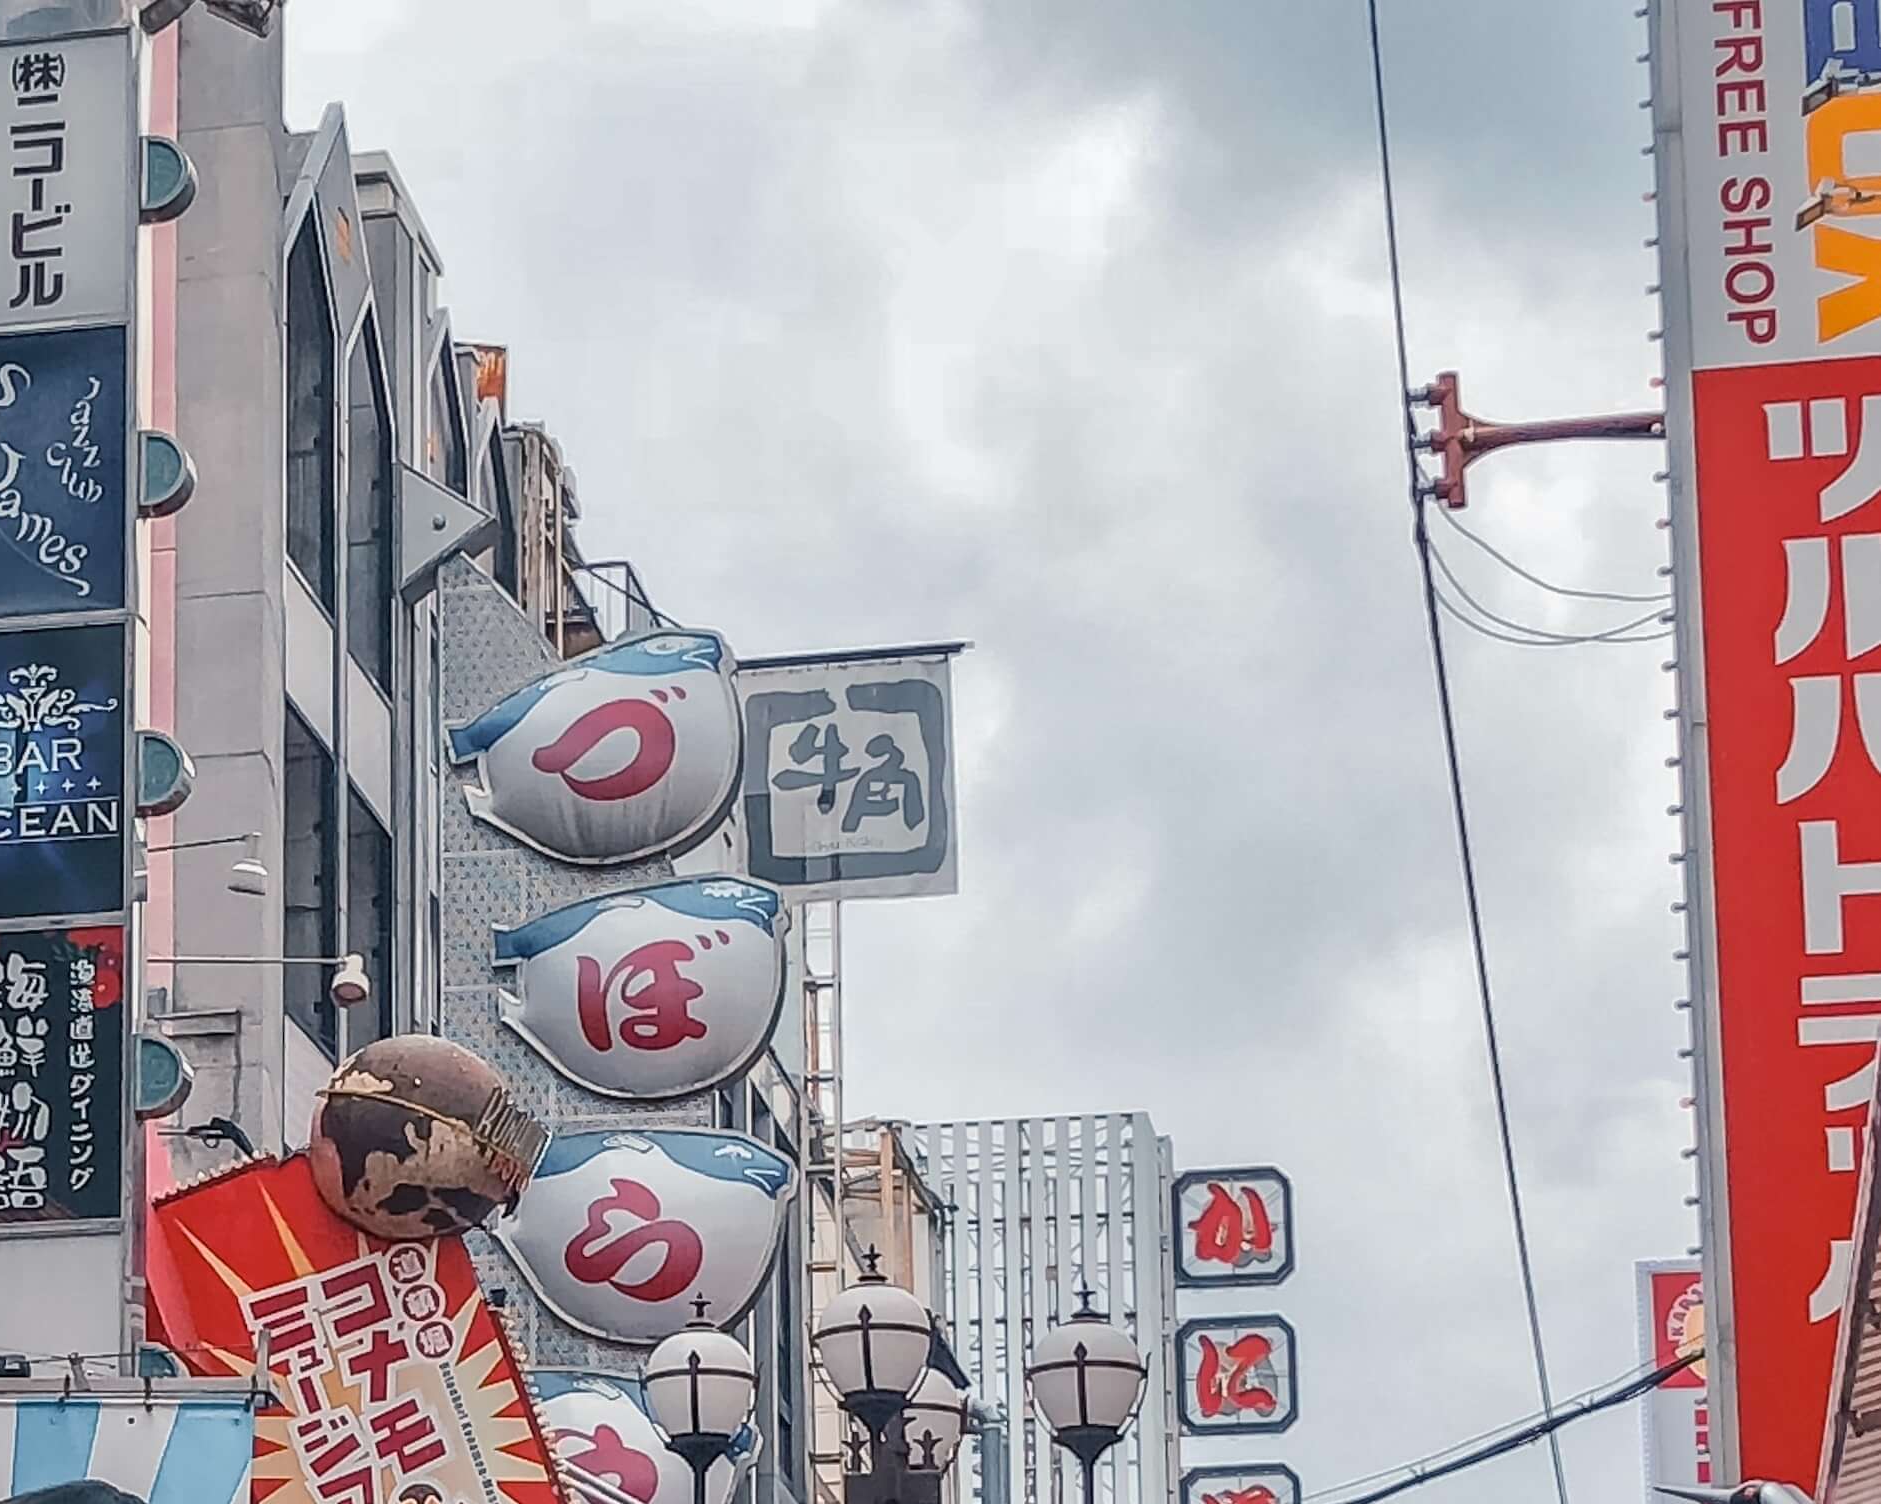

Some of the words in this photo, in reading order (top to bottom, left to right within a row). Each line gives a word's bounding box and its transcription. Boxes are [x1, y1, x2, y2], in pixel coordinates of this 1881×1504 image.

[1713, 0, 1769, 157] FREE
[1720, 177, 1778, 345] SHOP
[771, 722, 925, 833] 牛角
